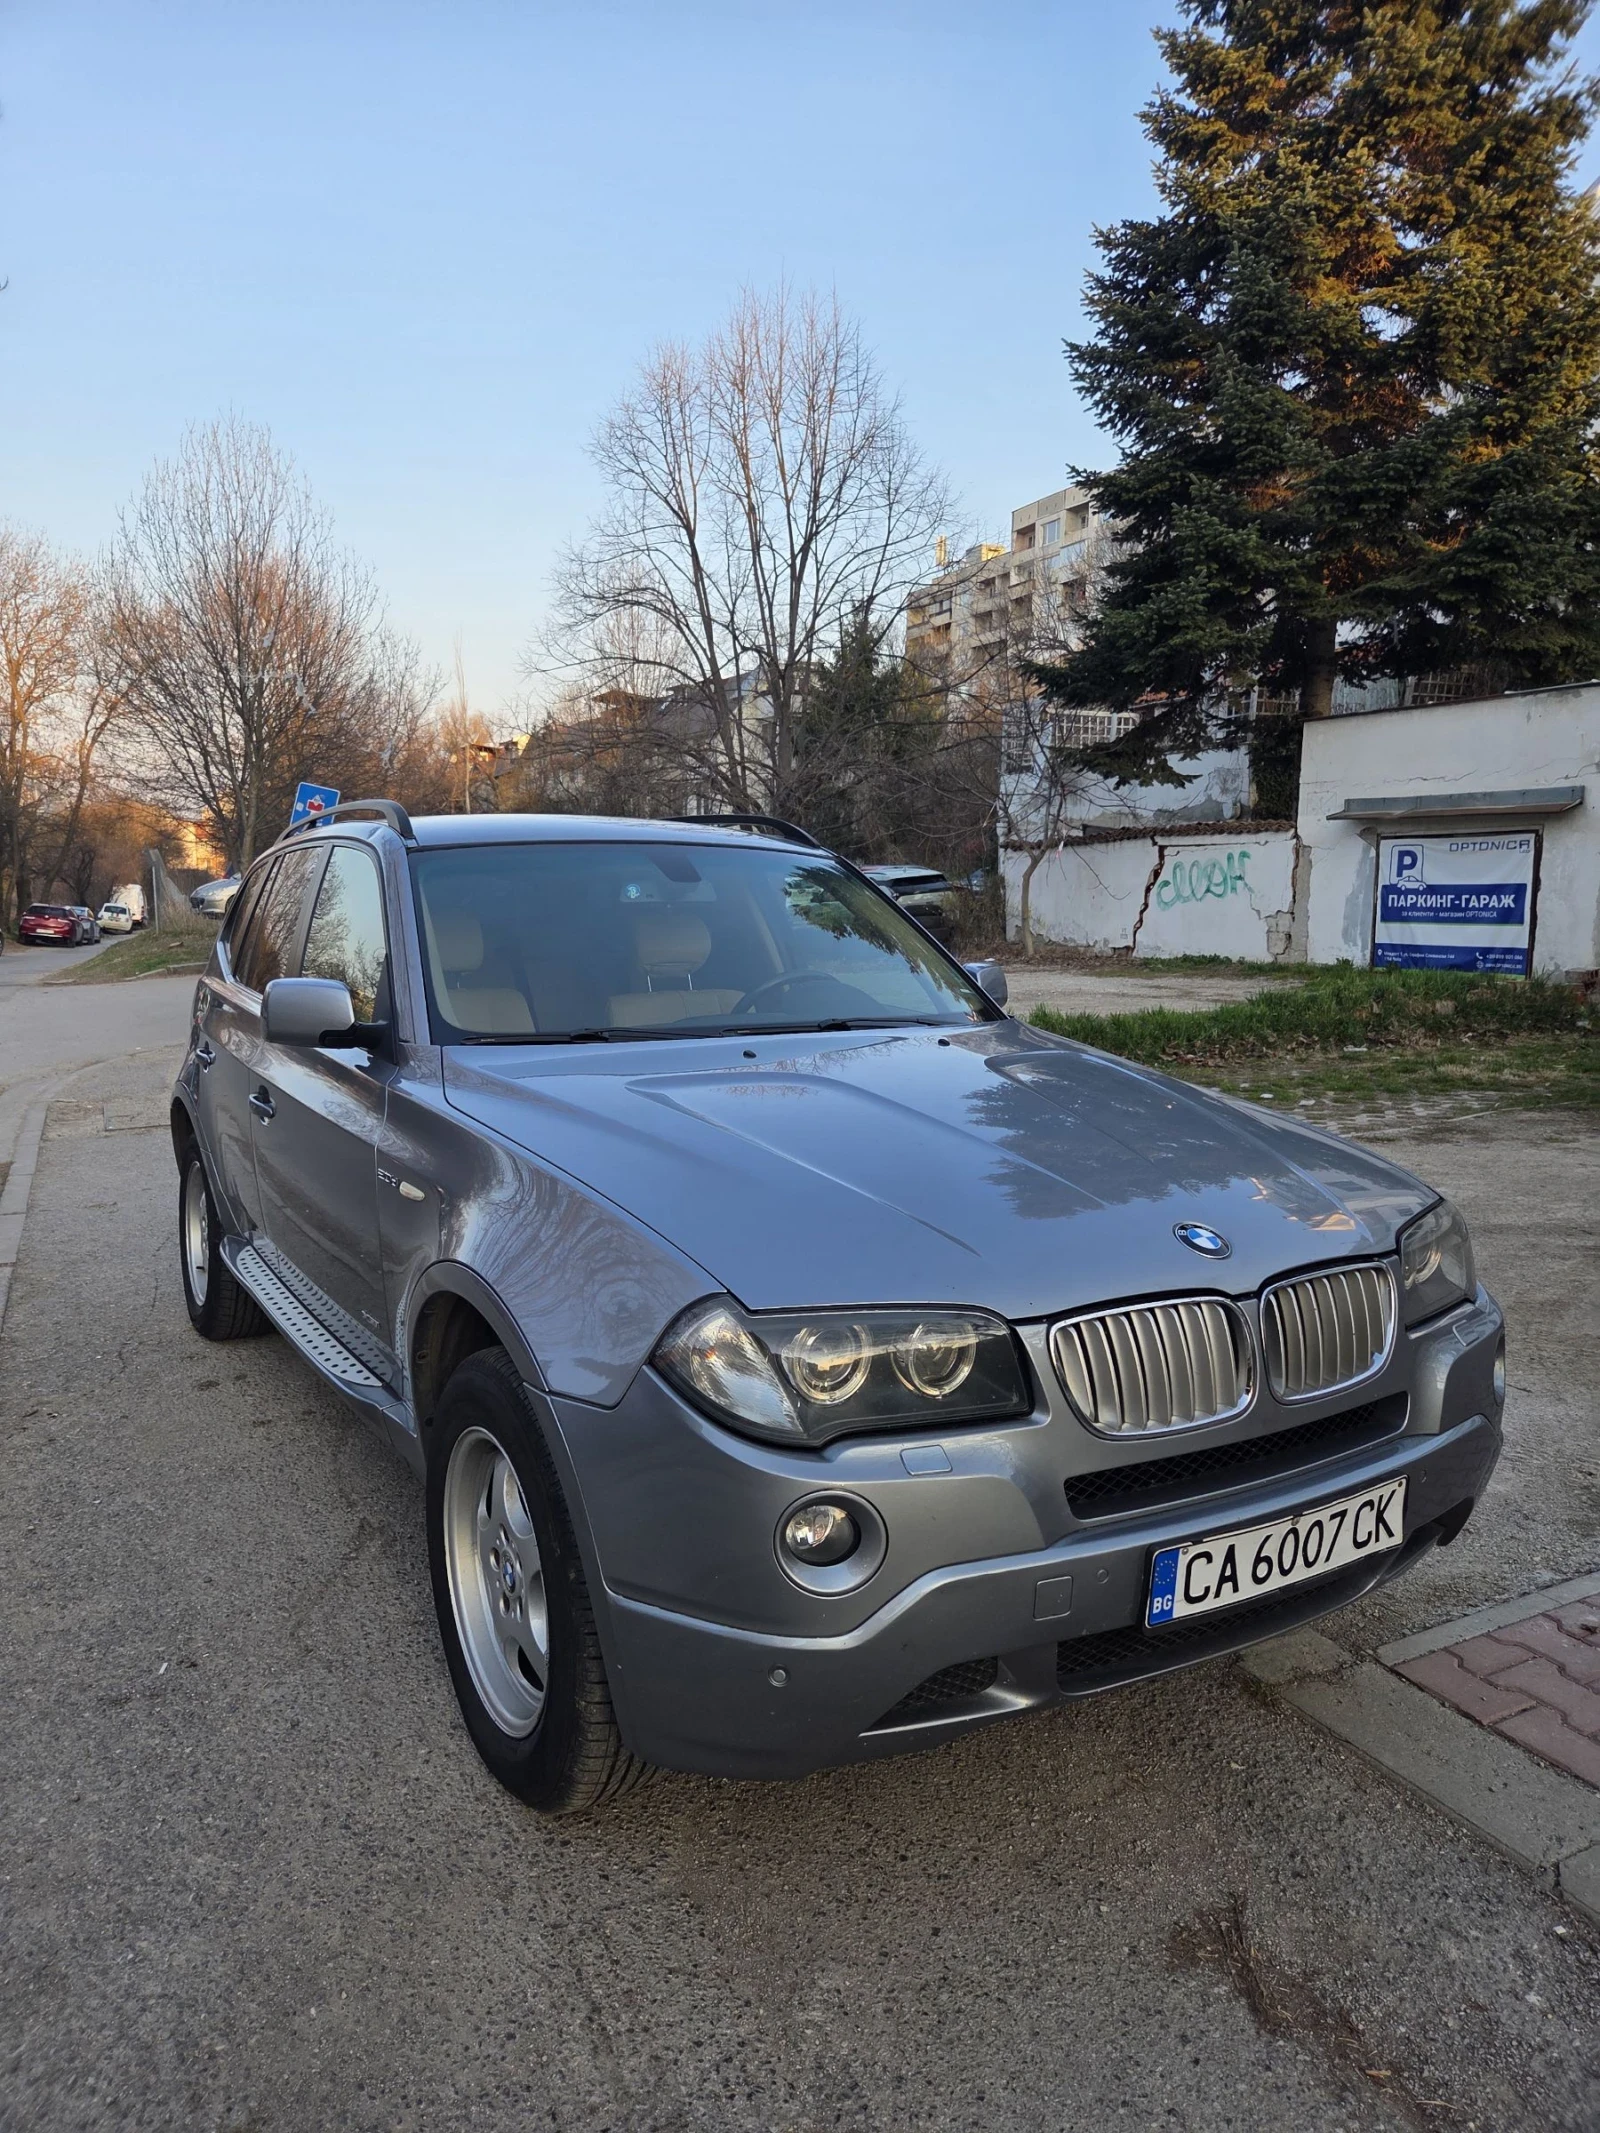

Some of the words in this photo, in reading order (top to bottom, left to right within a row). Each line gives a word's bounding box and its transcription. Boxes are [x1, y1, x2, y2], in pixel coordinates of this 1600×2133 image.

[1449, 840, 1530, 852] OPTONICA
[1396, 850, 1418, 878] P
[1388, 894, 1516, 908] ПАРКИНГ-ГАРАЖ
[1251, 1508, 1349, 1586] 6007
[1152, 1594, 1173, 1614] BG
